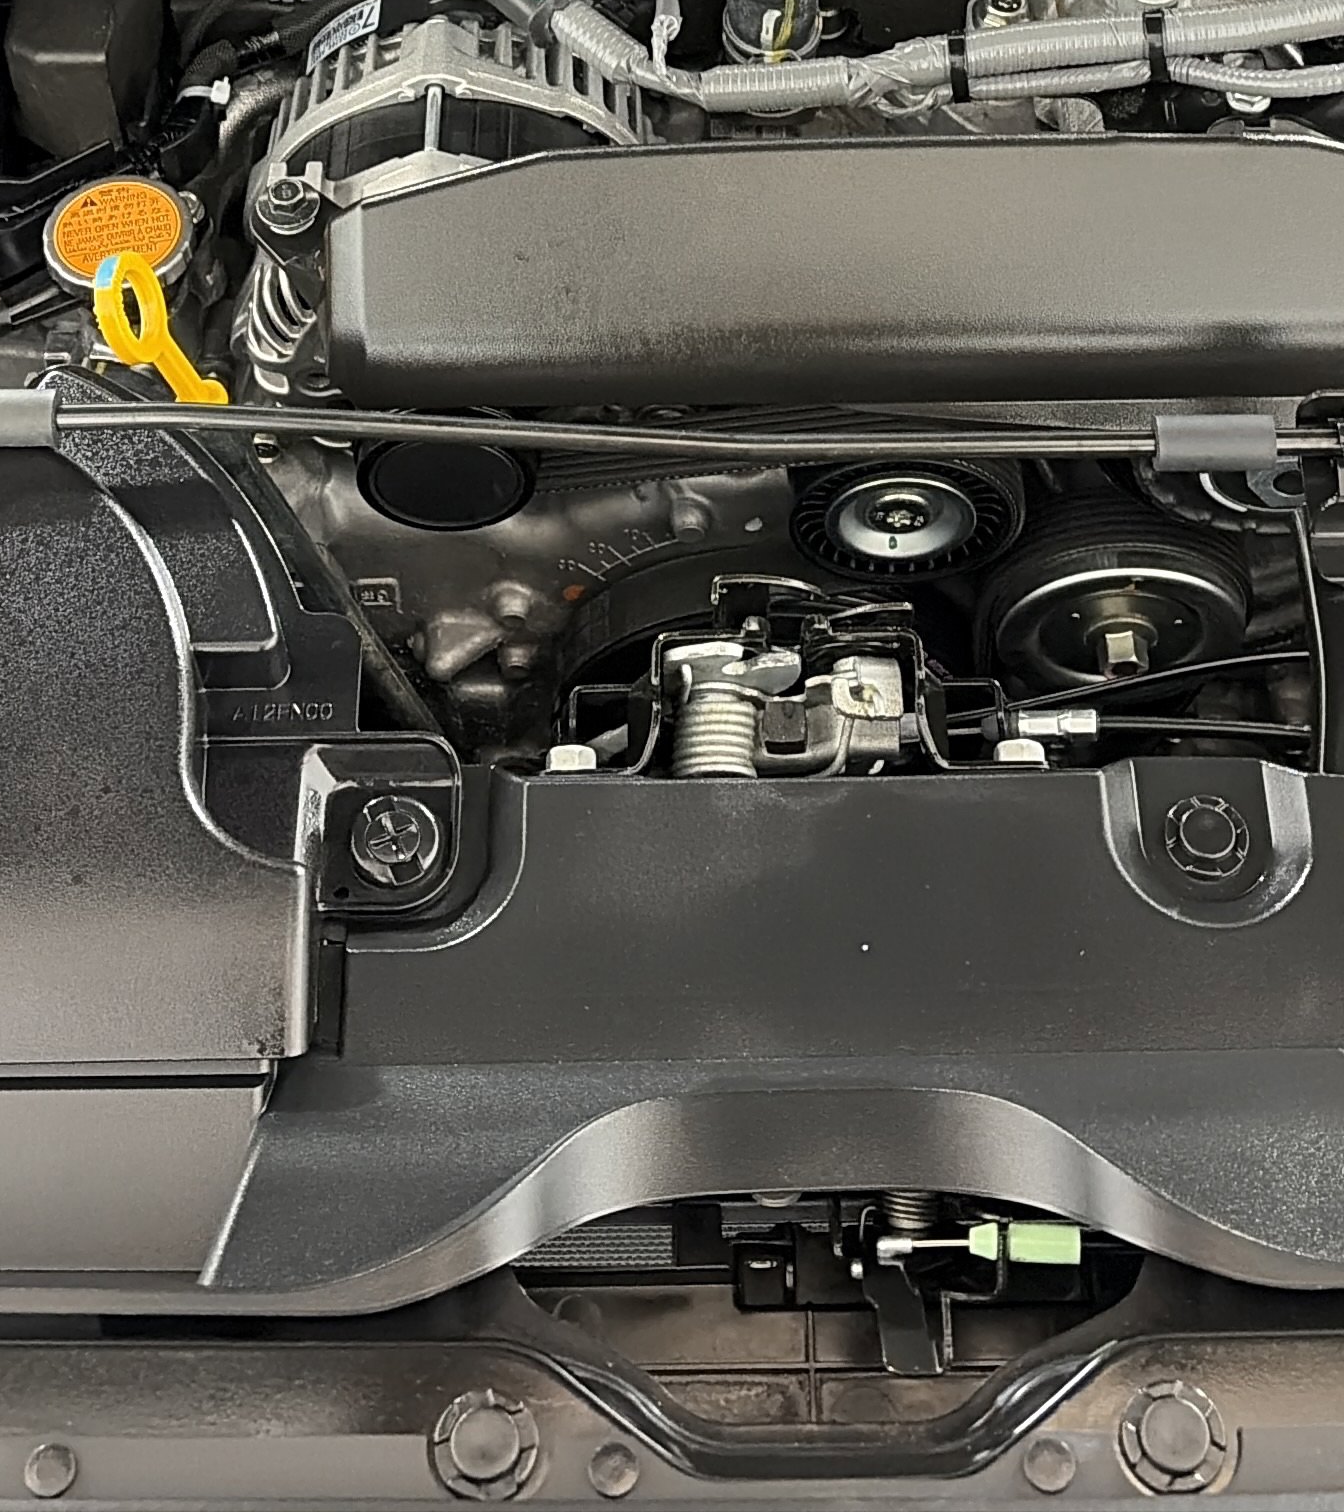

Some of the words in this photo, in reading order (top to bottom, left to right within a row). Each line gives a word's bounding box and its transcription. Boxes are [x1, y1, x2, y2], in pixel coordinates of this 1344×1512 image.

[98, 191, 148, 206] WARNING
[62, 227, 92, 239] NEVER
[94, 221, 119, 233] OPEN
[121, 216, 150, 228] WHEN
[76, 234, 105, 246] JAMAIS
[106, 229, 136, 241] OUVRIR
